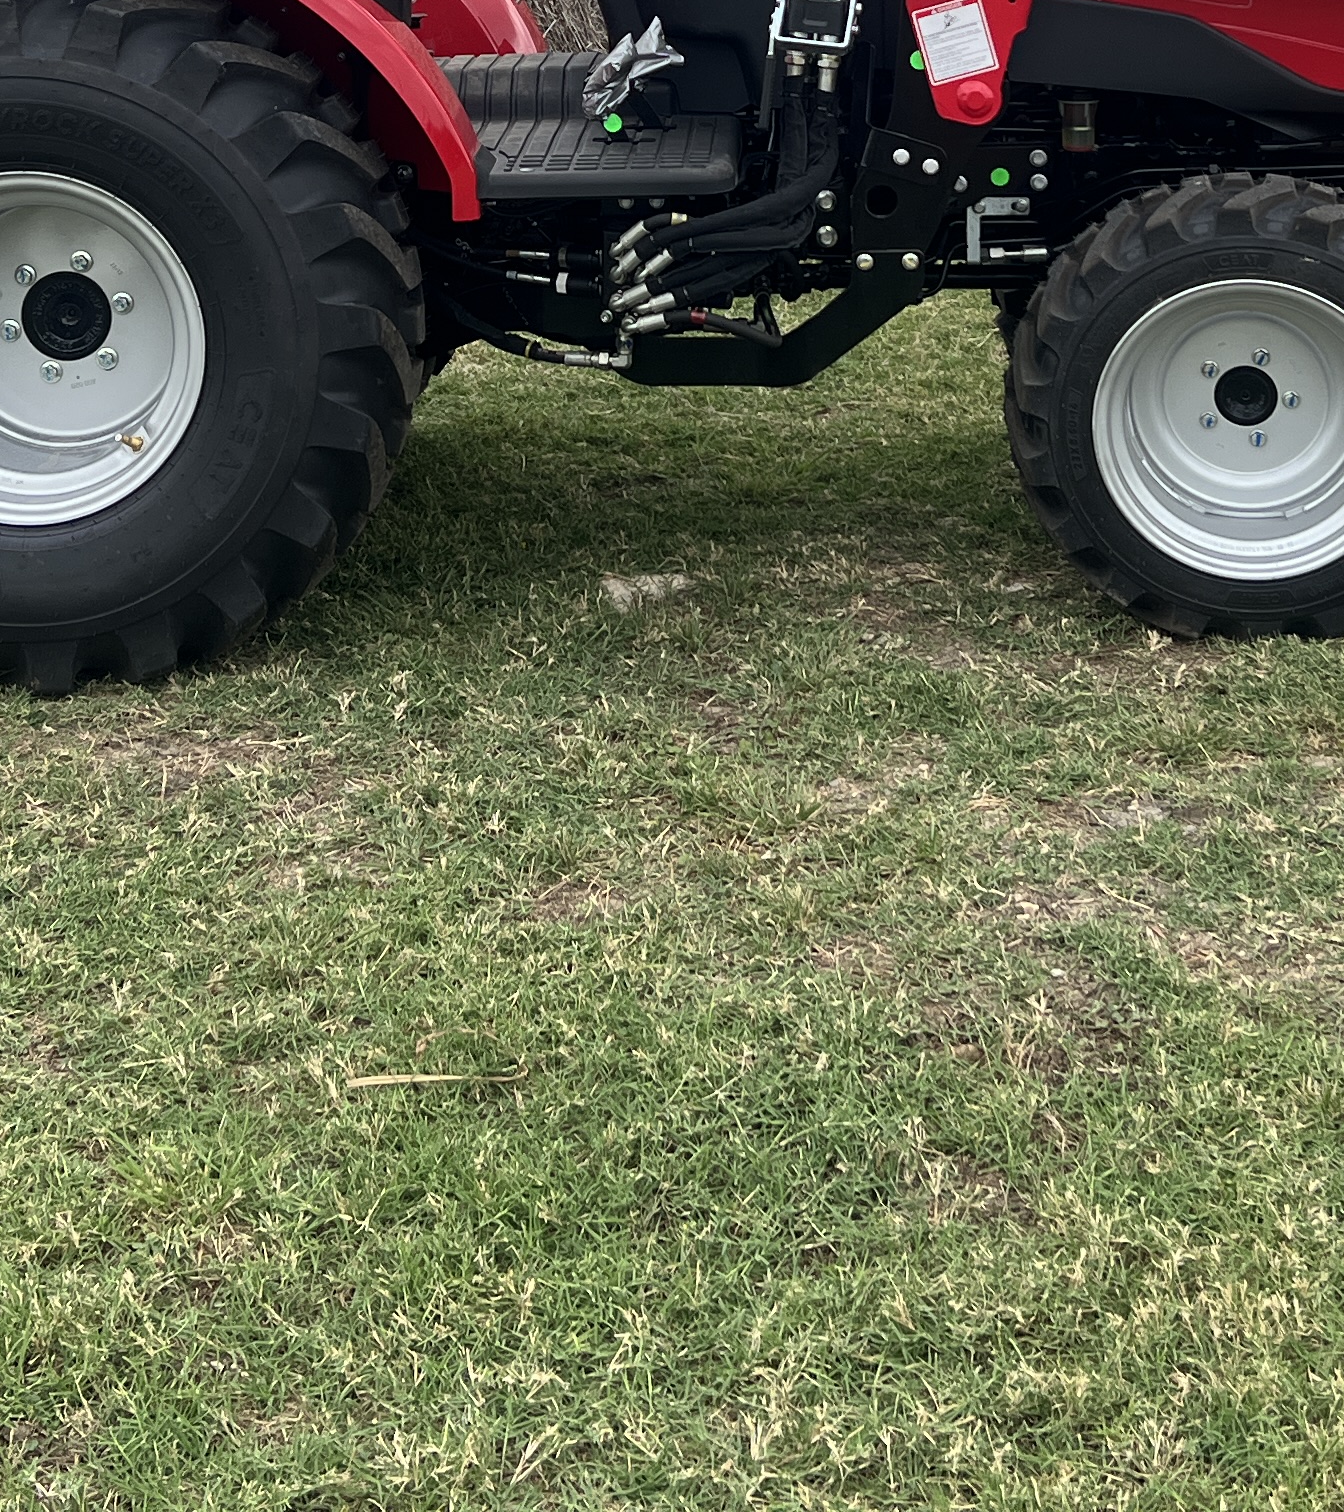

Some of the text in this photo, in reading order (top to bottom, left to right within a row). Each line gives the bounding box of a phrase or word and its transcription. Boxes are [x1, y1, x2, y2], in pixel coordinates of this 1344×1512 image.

[102, 127, 194, 198] SUPER
[1219, 253, 1260, 267] CEAT
[209, 399, 264, 496] CEAT
